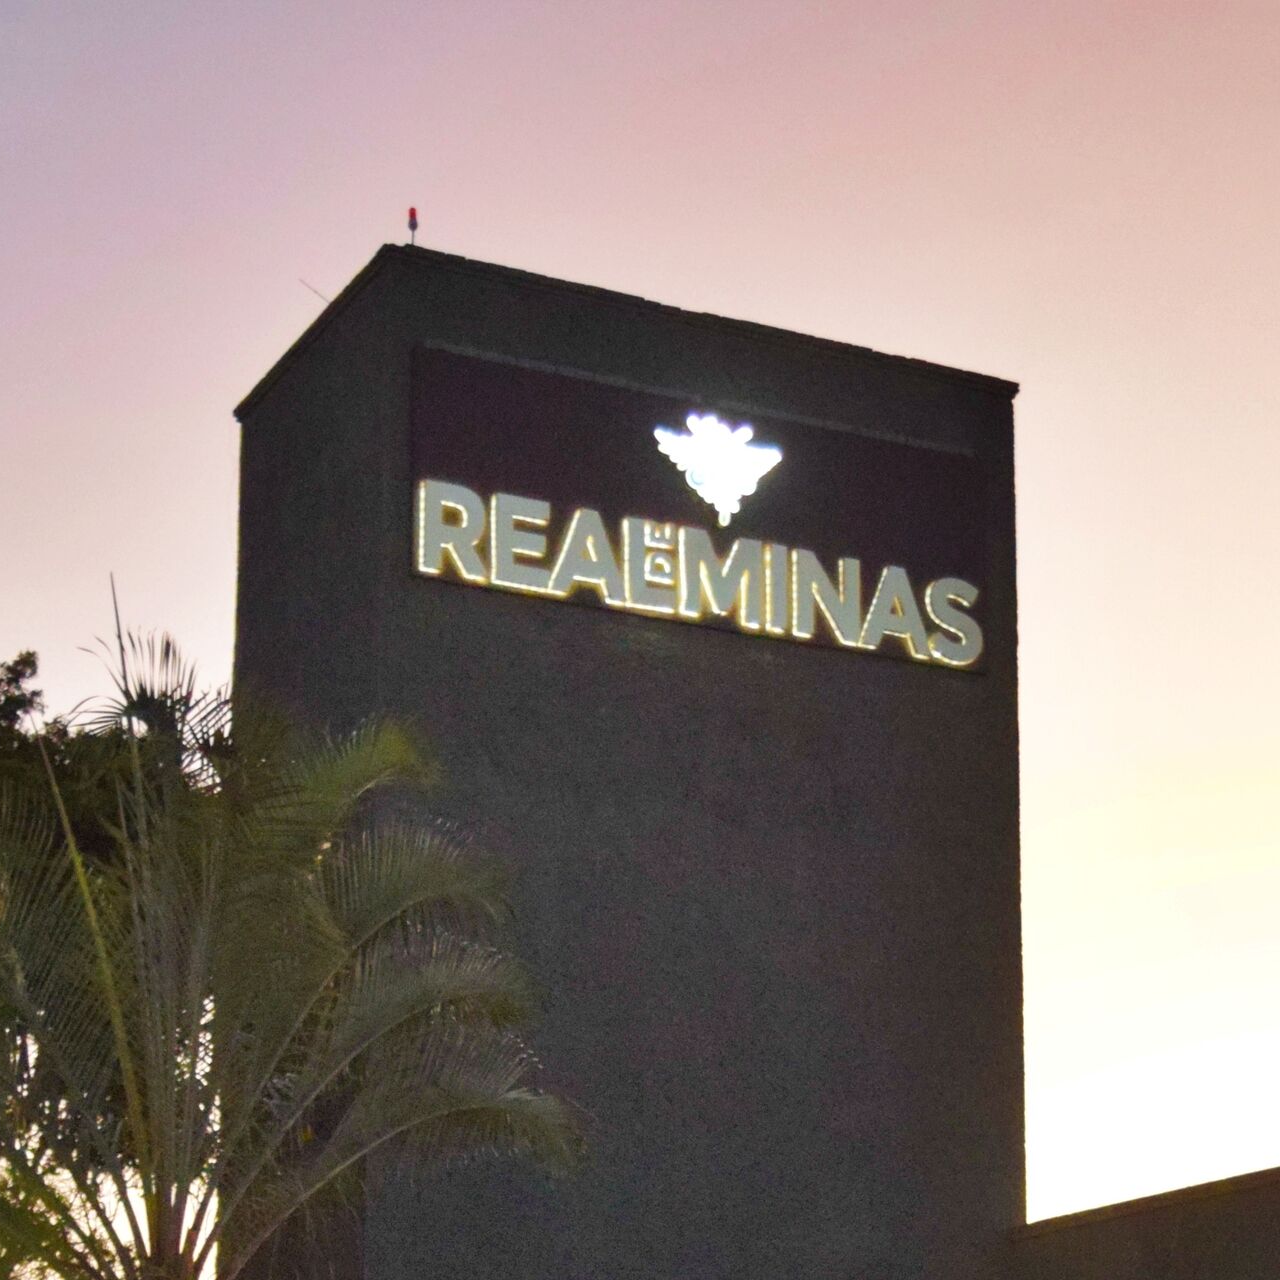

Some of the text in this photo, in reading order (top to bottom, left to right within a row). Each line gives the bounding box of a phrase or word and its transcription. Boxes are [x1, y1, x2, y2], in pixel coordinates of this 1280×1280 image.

[417, 478, 985, 668] REAL DE MINAS
